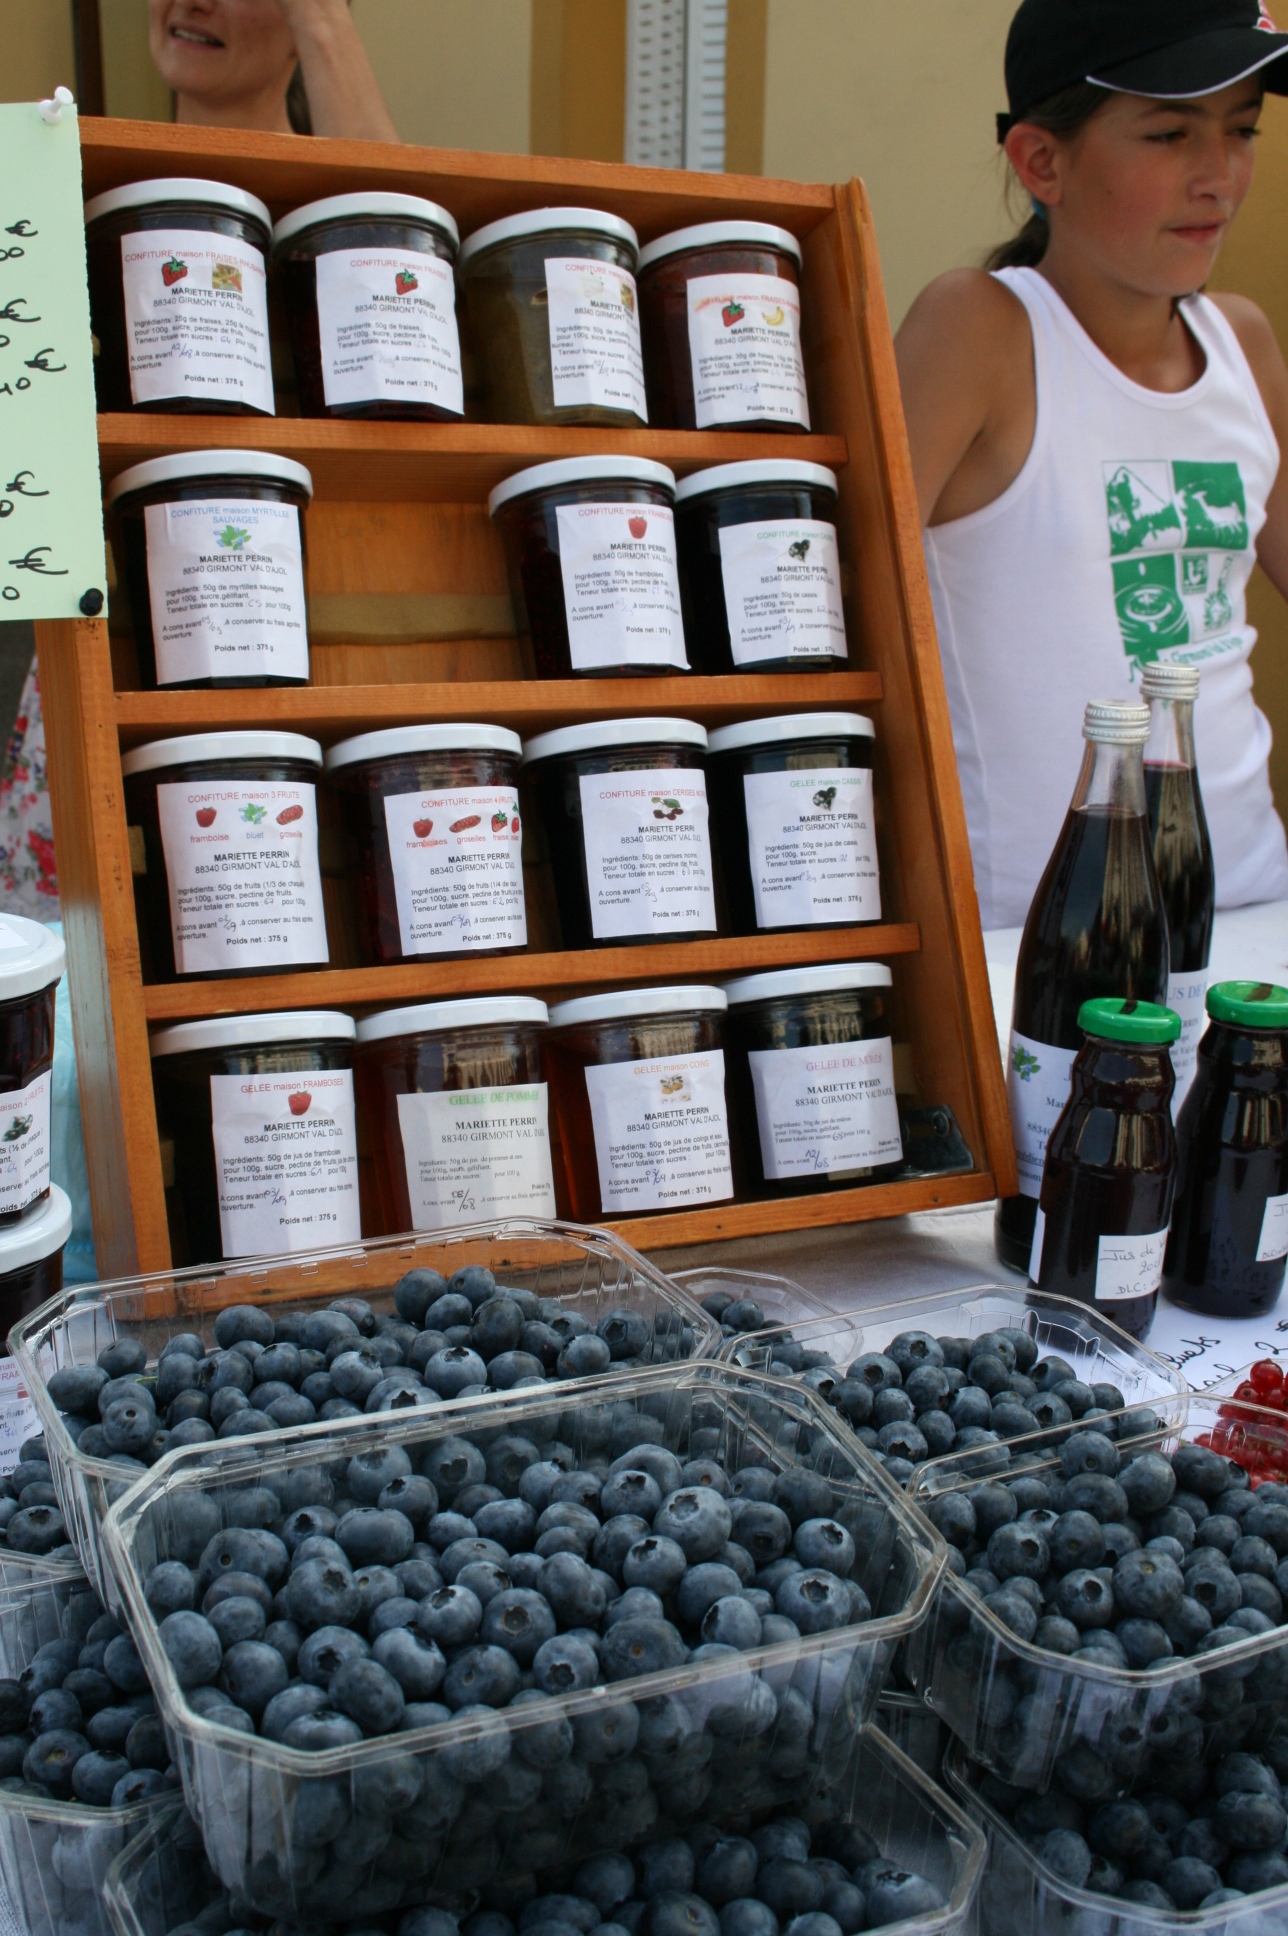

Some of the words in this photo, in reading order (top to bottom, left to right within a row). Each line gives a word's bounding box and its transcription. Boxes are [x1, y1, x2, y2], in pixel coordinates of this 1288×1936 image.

[124, 250, 173, 262] CONFITURE
[350, 260, 397, 268] CONFITURE
[400, 262, 423, 271] maison
[565, 264, 606, 275] CONFITURE
[172, 288, 213, 297] MARIETTE
[216, 291, 243, 302] PERRIN
[153, 298, 177, 307] 88340
[179, 298, 217, 308] GIRMONT
[372, 295, 411, 304] MARIETTE
[414, 298, 436, 310] PERRIN
[590, 300, 622, 313] MARIETTE
[355, 304, 377, 313] 88340
[379, 304, 415, 314] GIRMONT
[595, 310, 625, 321] GIRMONT
[731, 327, 766, 335] MARIETTE
[768, 329, 790, 338] PERRIN
[715, 336, 736, 345] 88340
[738, 335, 769, 344] GIRMONT
[171, 507, 220, 518] CONFITURE
[578, 508, 624, 516] CONFITURE
[757, 531, 800, 540] CONFITURE
[200, 555, 243, 563] MARIETTE
[246, 555, 272, 563] PERRIN
[182, 565, 205, 575] 88340
[207, 564, 247, 572] GIRMONT
[760, 576, 782, 584] 88340
[188, 792, 239, 803] CONFITURE
[278, 791, 299, 799] FRUITS
[600, 790, 646, 799] CONFITURE
[421, 798, 469, 808] CONFITURE
[799, 814, 836, 822] MARIETTE
[638, 825, 673, 833] MARIETTE
[783, 825, 804, 833] 88340
[805, 823, 839, 831] GIRMONT
[190, 834, 229, 843] framboise
[246, 831, 264, 839] bluet
[457, 835, 486, 844] groseilles
[621, 836, 643, 844] 88340
[214, 852, 258, 862] MARIETTE
[260, 851, 290, 859] PERRIN
[448, 854, 485, 863] MARIETTE
[487, 852, 510, 860] PERRIN
[195, 865, 220, 874] 88340
[222, 862, 262, 871] GIRMONT
[430, 867, 453, 875] 88340
[456, 864, 489, 872] GIRMONT
[634, 1065, 661, 1074] GELEE
[664, 1063, 688, 1072] maison
[690, 1060, 709, 1068] COING
[806, 1060, 840, 1071] GELEE
[842, 1058, 856, 1067] DE
[241, 1084, 271, 1093] GELEE
[274, 1082, 301, 1090] maison
[303, 1078, 343, 1089] FRAMBOISES
[807, 1082, 856, 1094] MARIETTE
[859, 1079, 881, 1088] PERRIN
[449, 1093, 486, 1105] GELEE
[490, 1092, 504, 1102] DE
[795, 1098, 819, 1107] 88340
[821, 1093, 863, 1104] GIRMONT
[644, 1110, 684, 1120] MARIETTE
[686, 1107, 709, 1115] PERRIN
[264, 1121, 306, 1131] MARIETTE
[308, 1119, 335, 1127] PERRIN
[455, 1119, 508, 1130] MARIETTE
[510, 1117, 537, 1127] PERRIN
[627, 1124, 650, 1132] 88340
[652, 1119, 688, 1129] GIRMONT
[690, 1117, 703, 1125] VAL
[244, 1135, 269, 1143] 88340
[271, 1131, 310, 1141] GIRMONT
[441, 1134, 468, 1143] 88340
[470, 1131, 514, 1141] GIRMONT
[516, 1129, 533, 1138] VAL
[279, 1216, 300, 1225] Poids
[302, 1215, 313, 1223] net
[319, 1213, 331, 1221] 375
